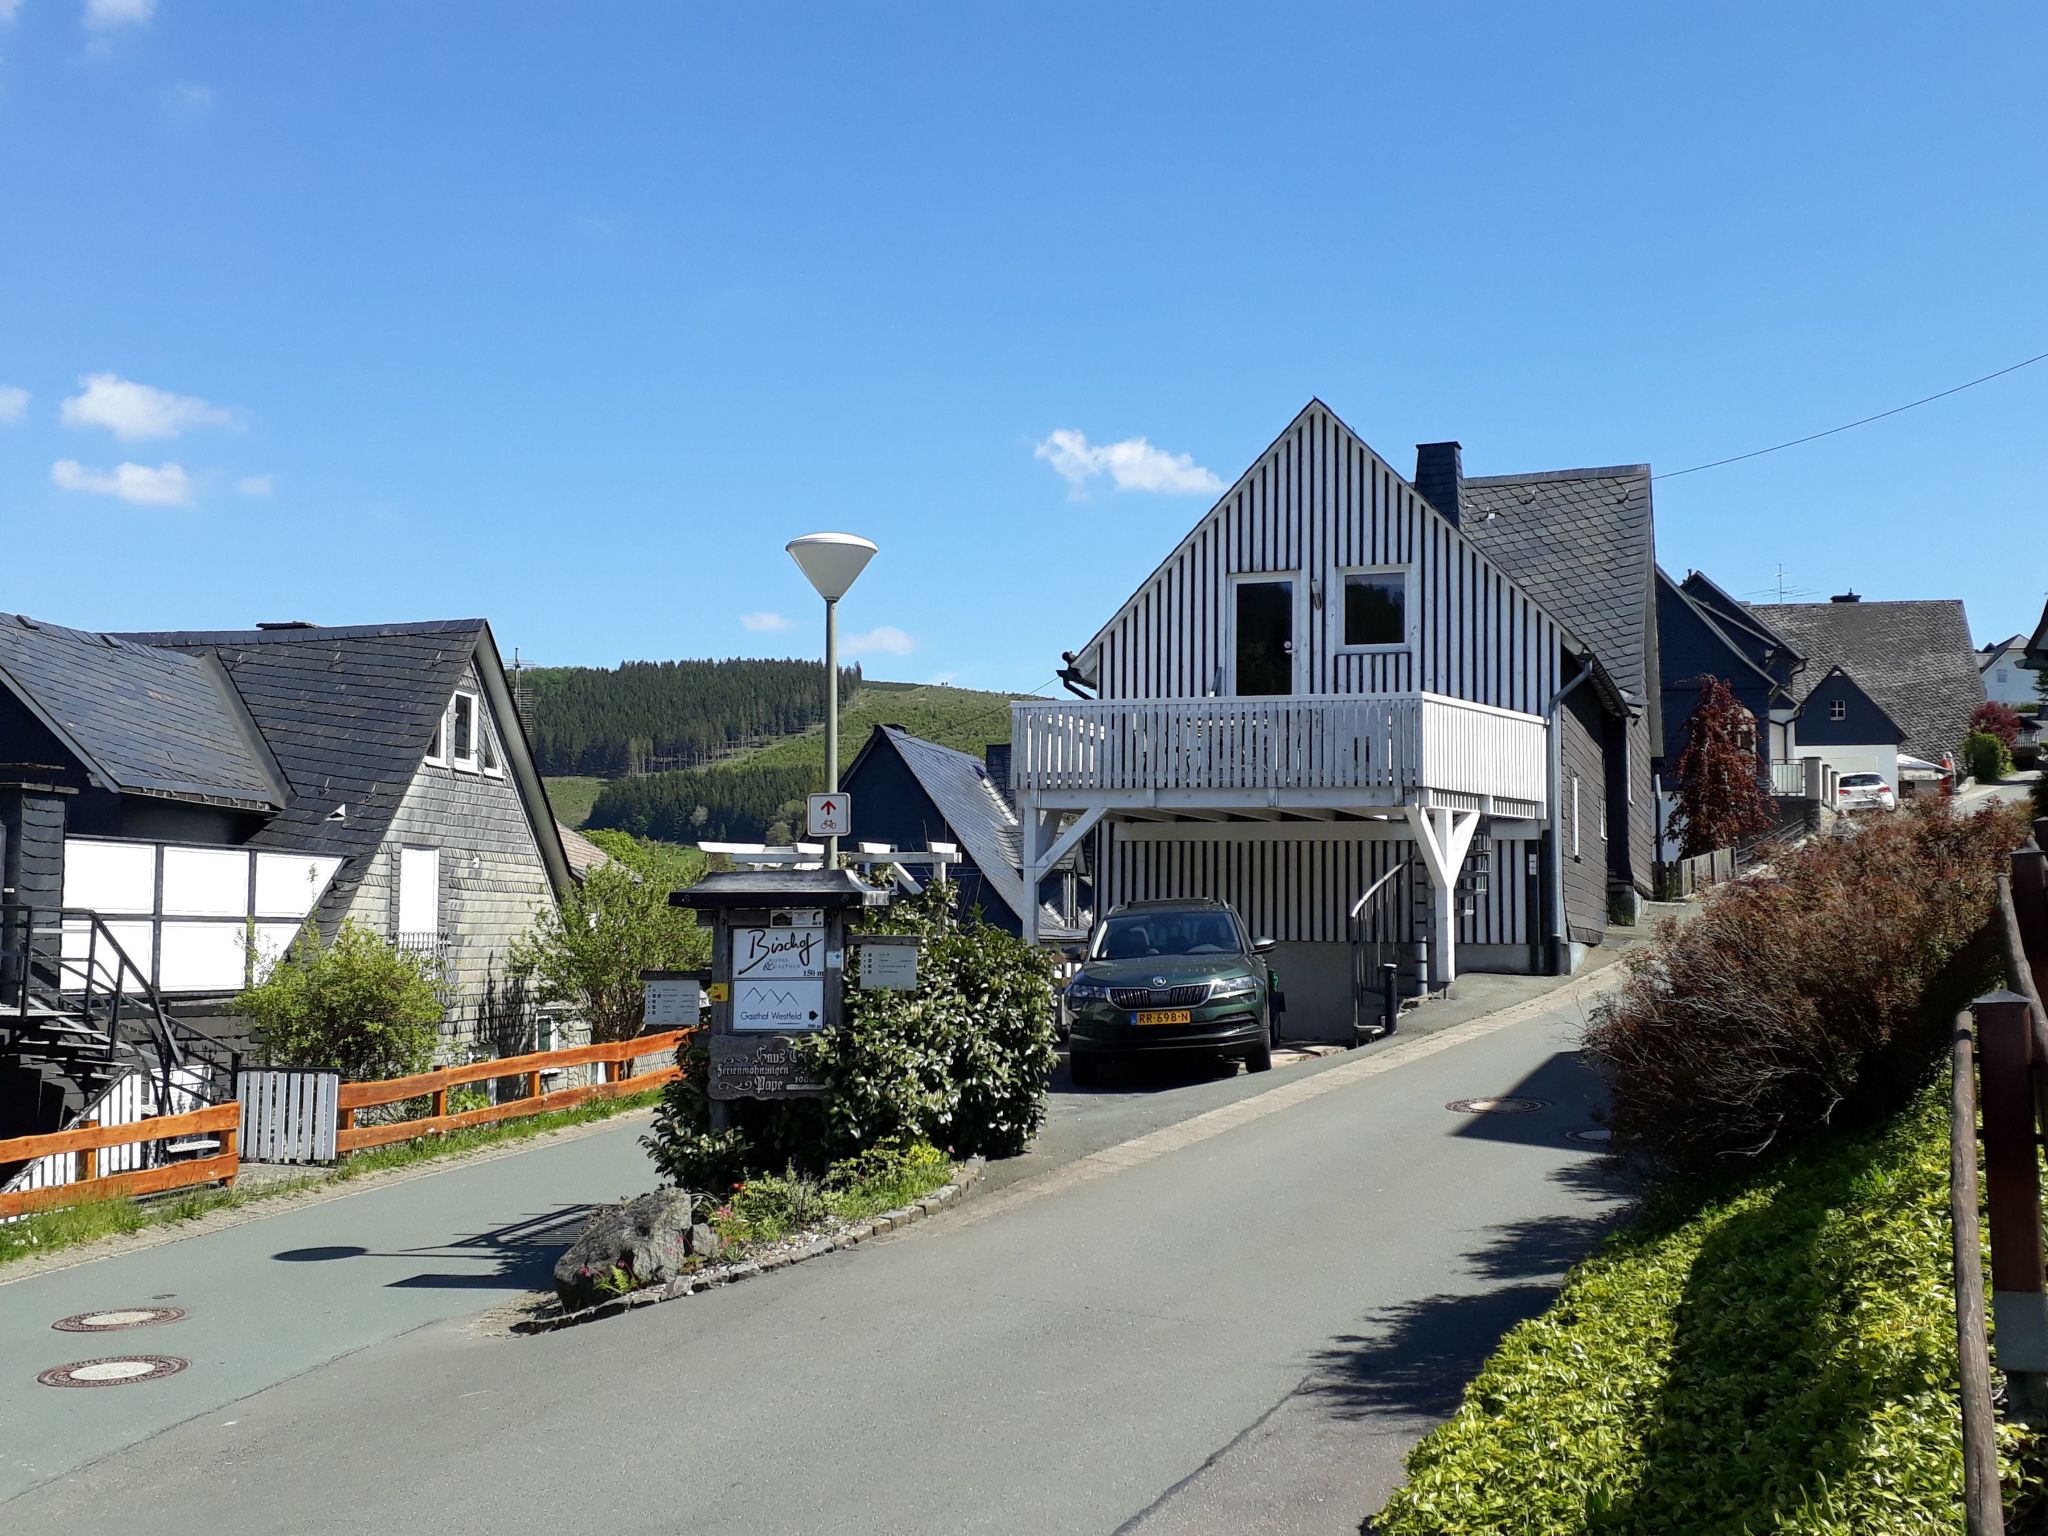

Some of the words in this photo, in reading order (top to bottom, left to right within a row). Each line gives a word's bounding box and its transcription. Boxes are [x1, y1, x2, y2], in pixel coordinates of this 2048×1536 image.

[738, 929, 823, 974] Bischof
[740, 1010, 769, 1020] Gasthof
[771, 1010, 802, 1020] Westfeld
[1139, 1012, 1188, 1024] RR-698-N
[716, 1063, 789, 1078] Ferienwohnungen
[754, 1075, 783, 1094] Pape
